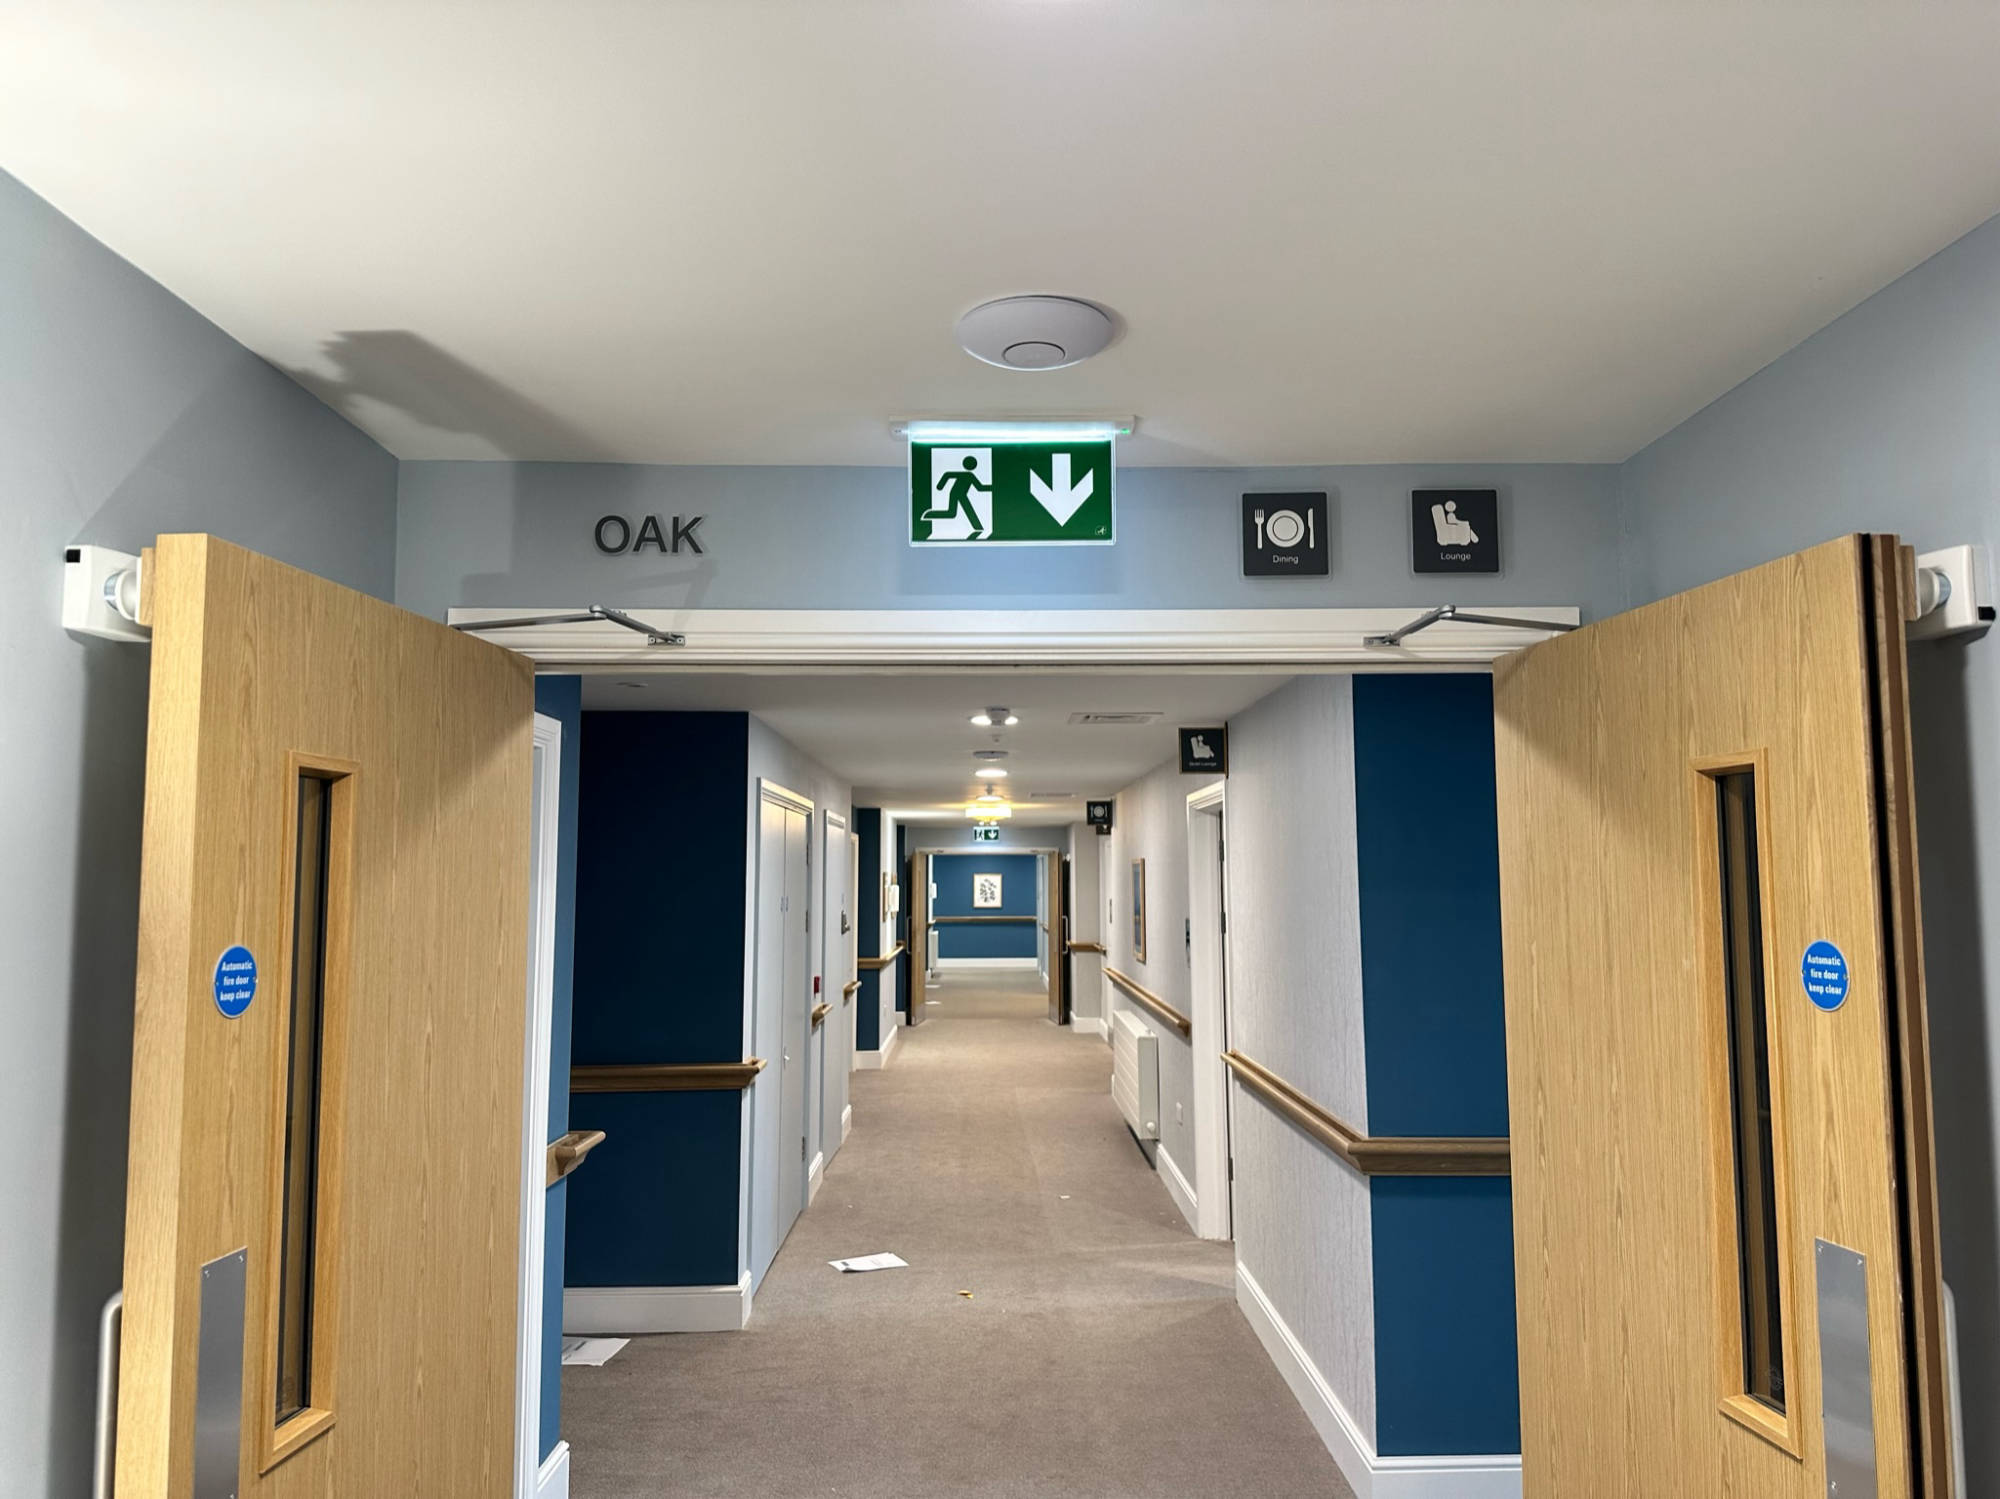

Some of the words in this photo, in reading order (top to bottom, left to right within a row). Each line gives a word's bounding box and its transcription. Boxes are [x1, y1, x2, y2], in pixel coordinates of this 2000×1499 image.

[595, 515, 703, 553] OAK
[1272, 555, 1299, 564] Dining
[1440, 552, 1471, 561] Lounge
[222, 961, 253, 971] Automatic
[1807, 954, 1841, 966] Automatic
[1810, 968, 1822, 979] fire
[1823, 970, 1838, 980] door
[223, 976, 234, 986] fire
[236, 976, 249, 985] door
[1808, 981, 1824, 995] keep
[1825, 984, 1842, 995] clear
[220, 991, 234, 1002] keep
[235, 989, 251, 999] clear
